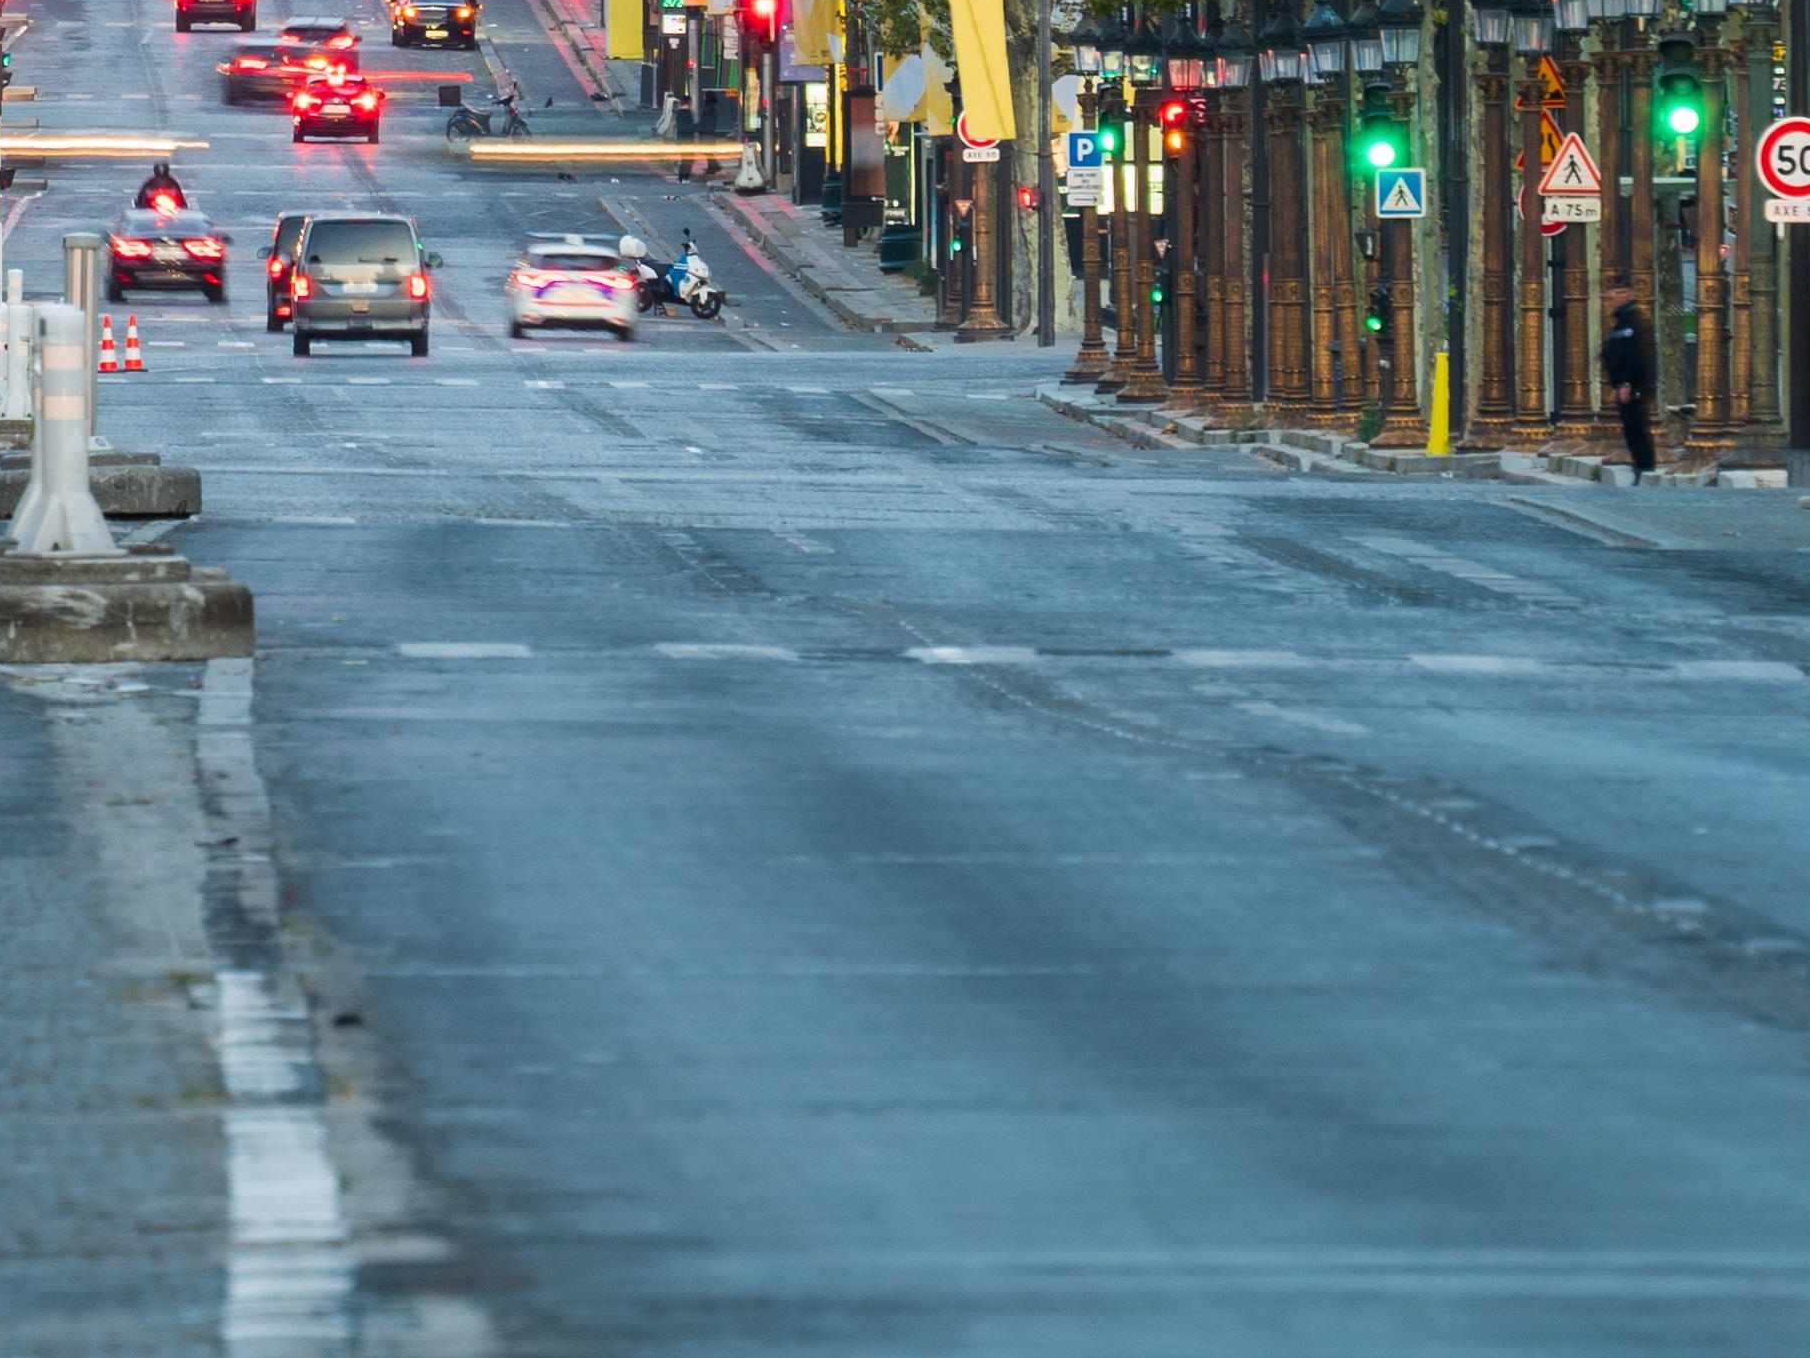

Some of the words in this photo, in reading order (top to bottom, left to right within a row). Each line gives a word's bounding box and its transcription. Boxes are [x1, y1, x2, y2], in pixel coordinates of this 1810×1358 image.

[1076, 137, 1094, 162] P
[1551, 203, 1560, 217] A
[1774, 204, 1800, 217] AXE
